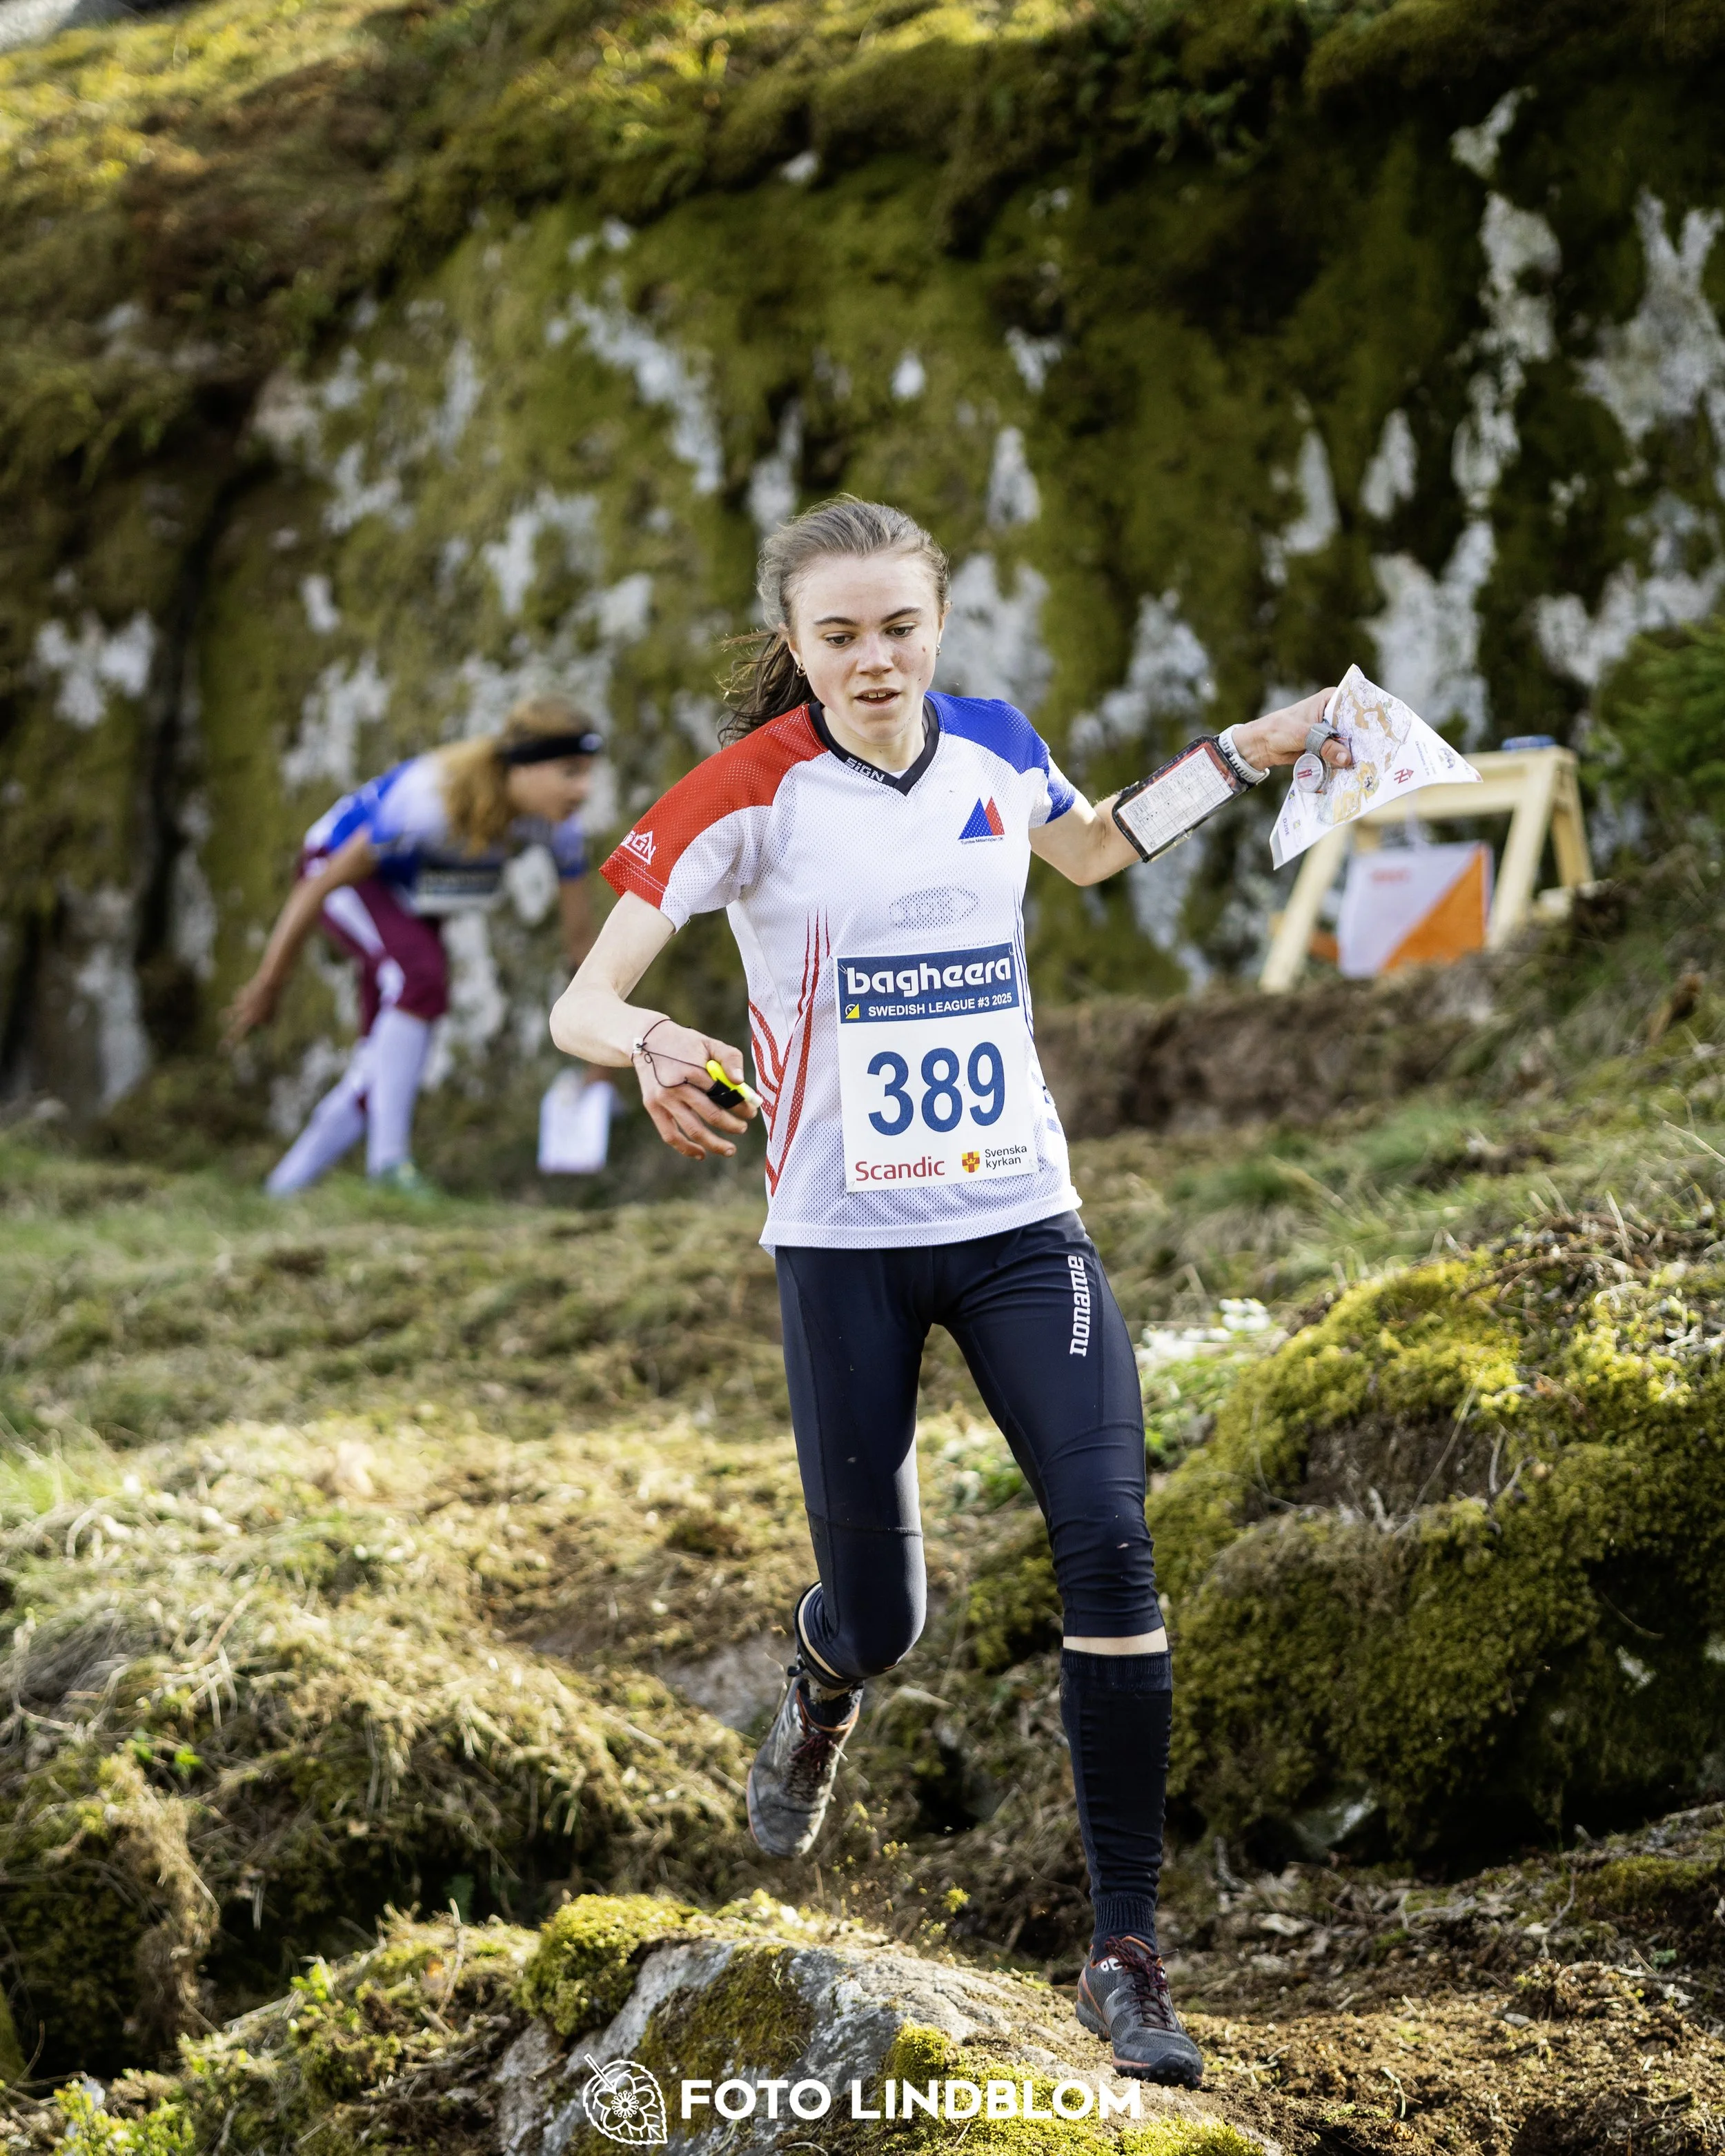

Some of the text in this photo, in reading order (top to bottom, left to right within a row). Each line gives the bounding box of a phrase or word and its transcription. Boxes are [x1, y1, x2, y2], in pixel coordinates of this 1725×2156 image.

[847, 957, 1012, 997] bagheera
[868, 992, 1012, 1017] SWEDISH LEAGUE #3 2025
[867, 1041, 1005, 1136] 389
[985, 1144, 1027, 1158] Svenska
[986, 1155, 1021, 1169] kyrkan
[855, 1156, 945, 1181] Scandic
[1067, 1255, 1090, 1357] noname
